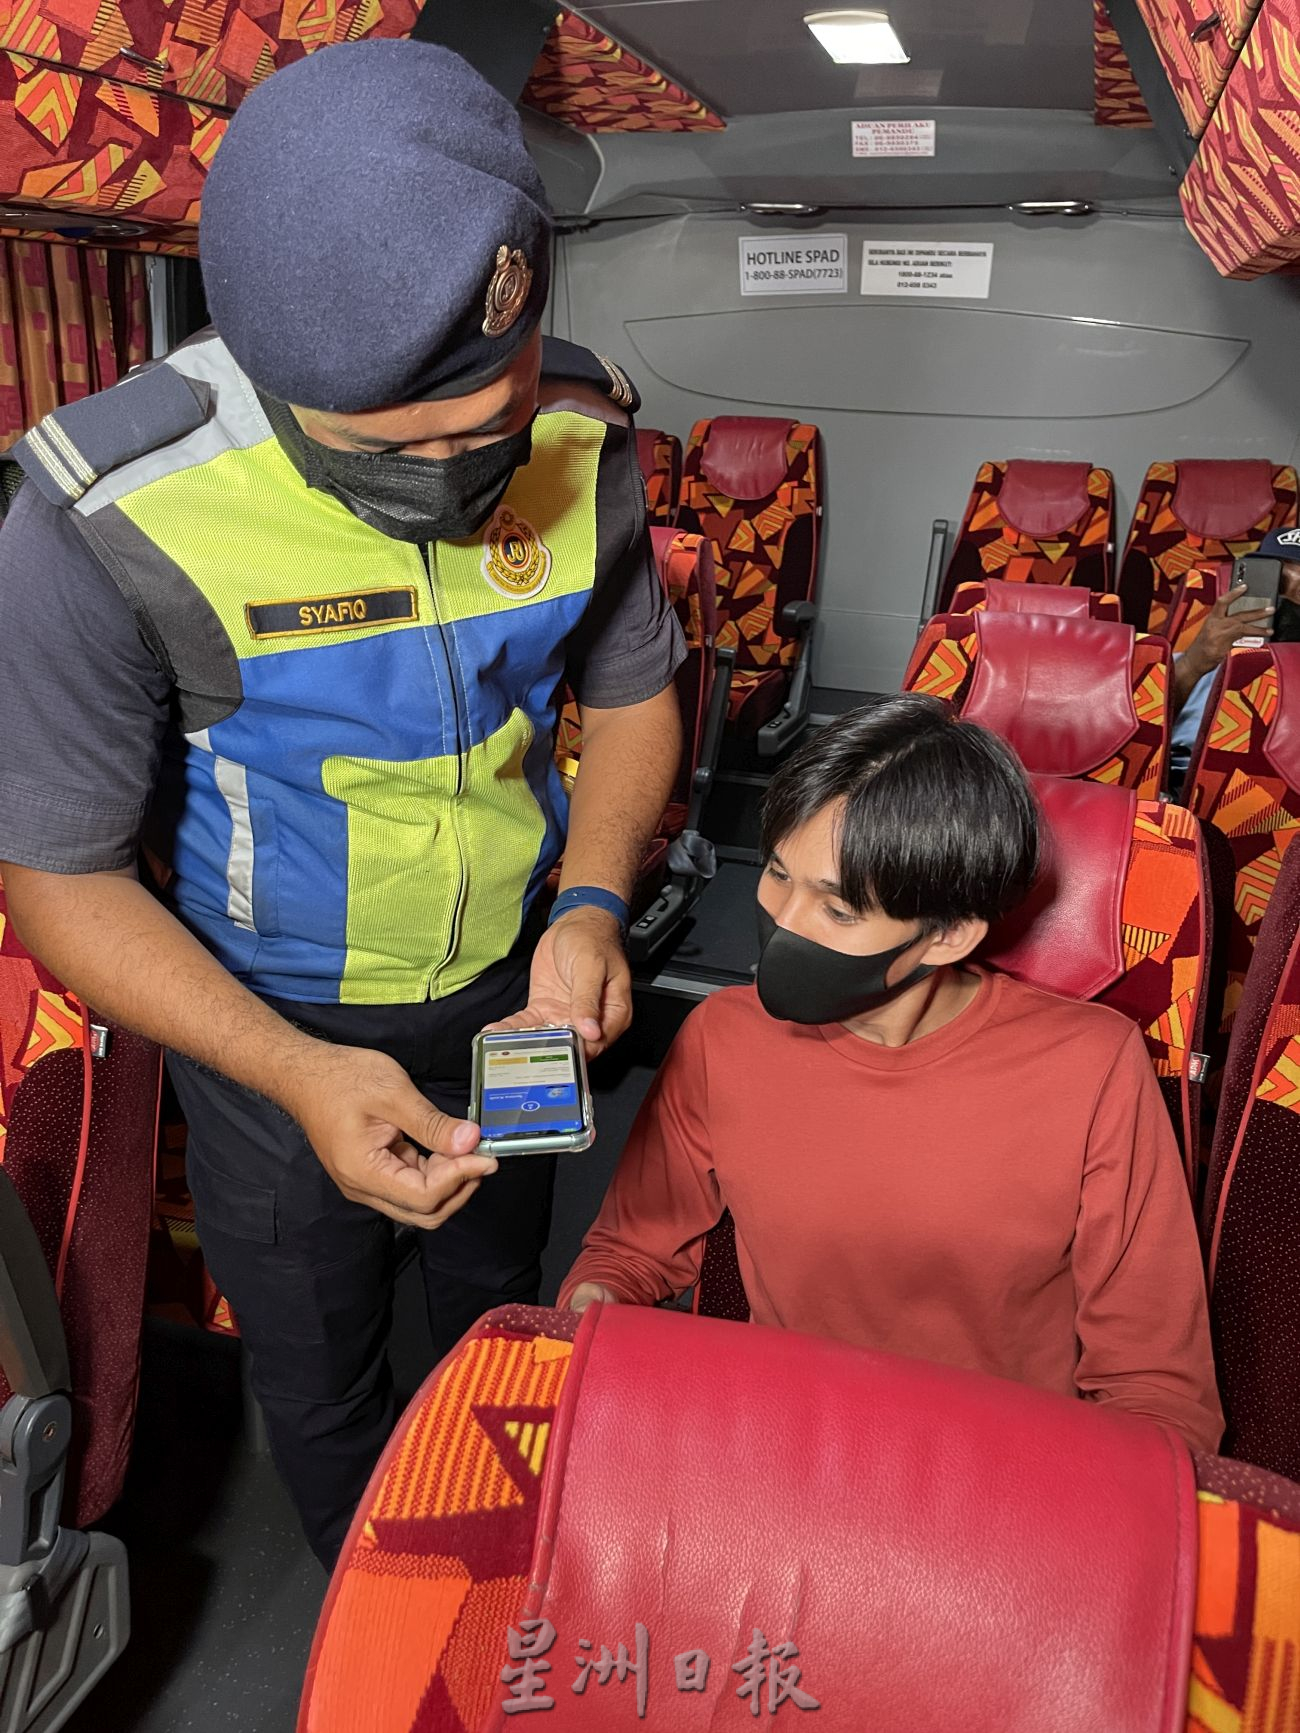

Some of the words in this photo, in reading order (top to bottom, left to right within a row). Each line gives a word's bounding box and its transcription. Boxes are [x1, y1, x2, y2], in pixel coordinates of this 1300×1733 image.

[746, 251, 802, 265] HOTLINE
[805, 249, 840, 263] SPAD
[745, 268, 843, 280] 1-800-88-SPAD(7723)
[299, 599, 368, 627] SYAFIQ
